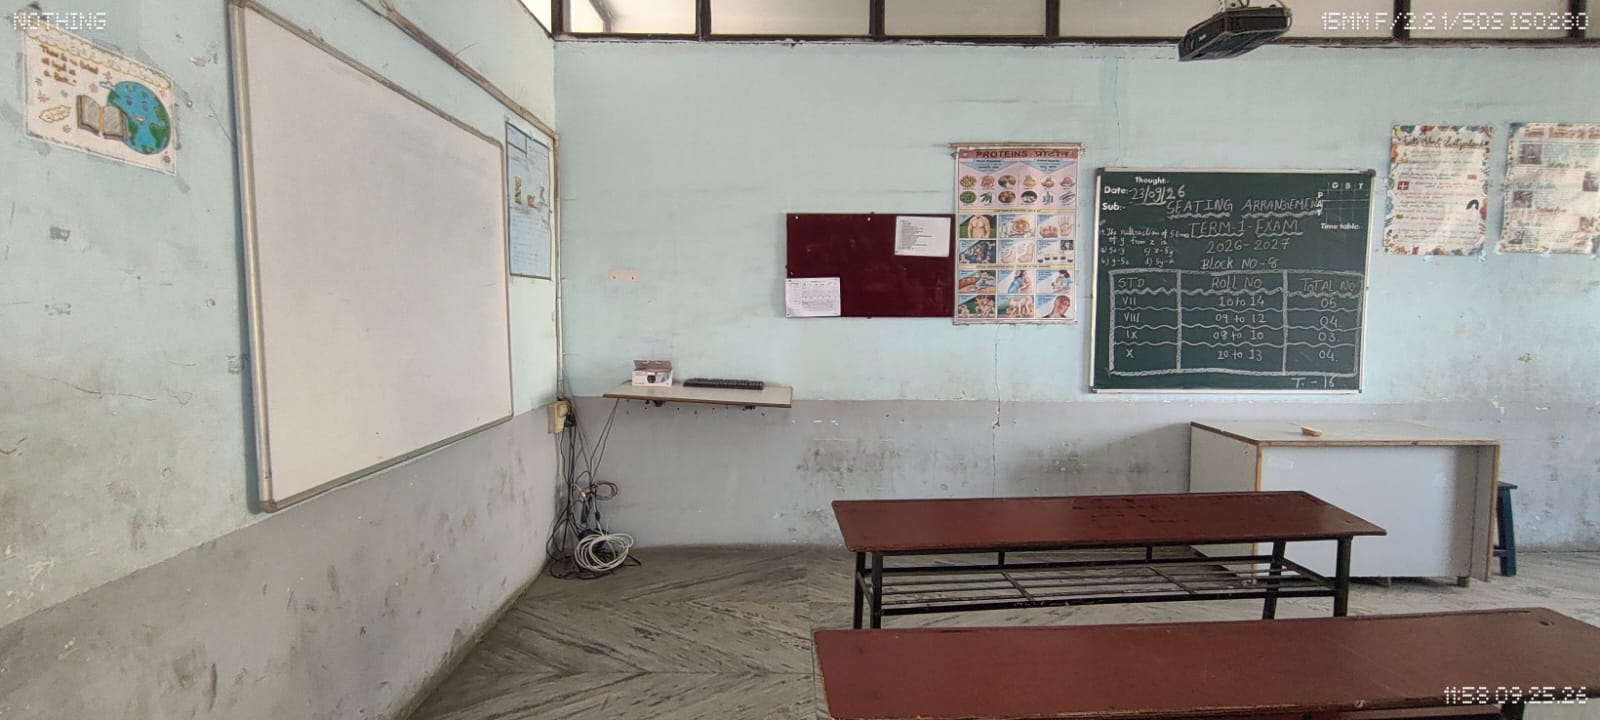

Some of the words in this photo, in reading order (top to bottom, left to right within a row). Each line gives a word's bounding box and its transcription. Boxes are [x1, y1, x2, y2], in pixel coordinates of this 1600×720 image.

[976, 151, 1027, 159] PROTEINS
[1167, 199, 1233, 215] SEATING
[1206, 238, 1290, 255] 2026-2027
[1118, 277, 1145, 288] STD
[1320, 297, 1337, 309] 05
